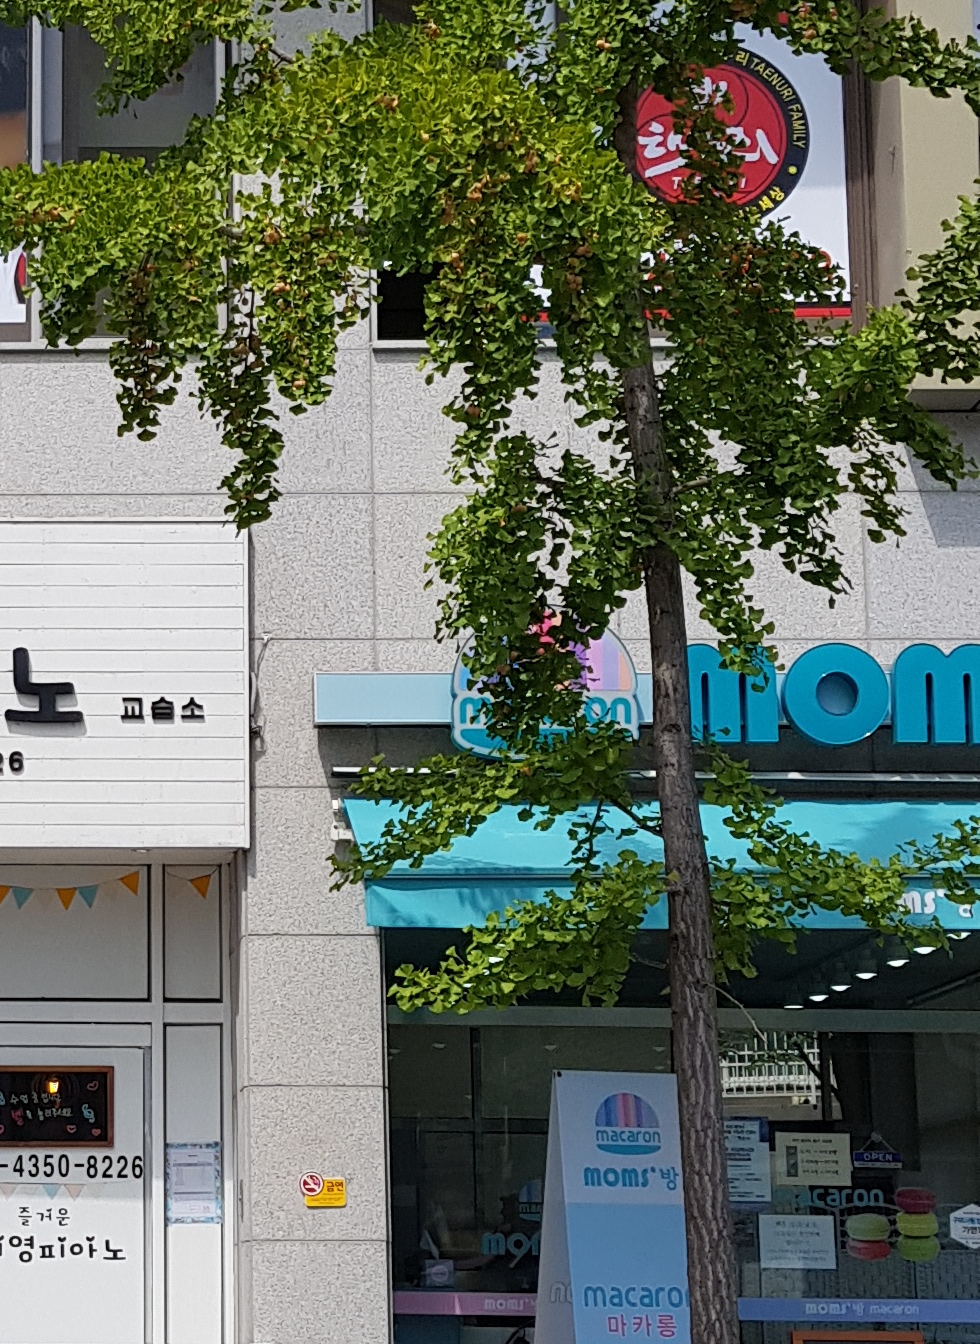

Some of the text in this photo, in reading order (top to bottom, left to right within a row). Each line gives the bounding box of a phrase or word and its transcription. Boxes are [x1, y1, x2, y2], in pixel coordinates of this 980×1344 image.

[750, 57, 807, 149] TAENURI FAMILY
[120, 696, 205, 721] 교습소
[595, 1128, 662, 1144] macaron
[863, 1152, 893, 1162] OPEN
[325, 1181, 344, 1193] 금연
[18, 1206, 71, 1227] 즐거운
[606, 1313, 678, 1338] 마카롱
